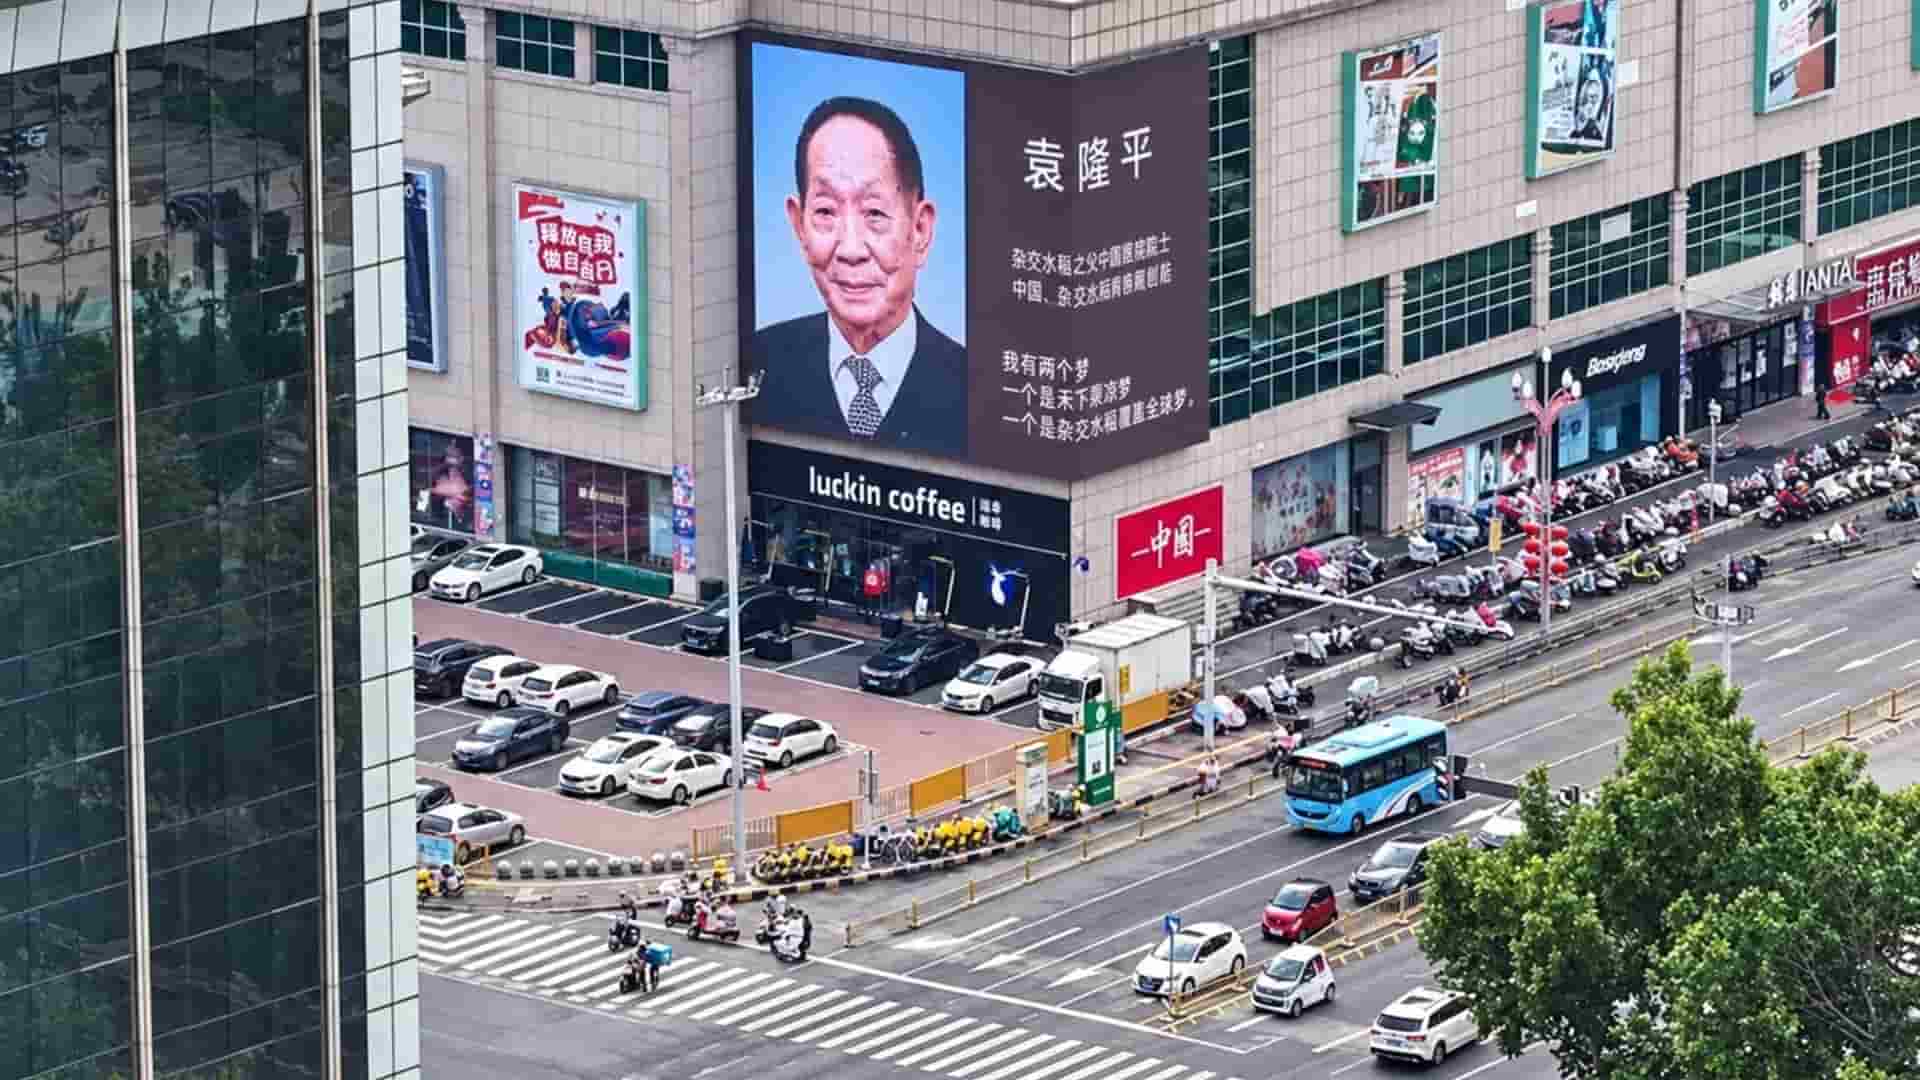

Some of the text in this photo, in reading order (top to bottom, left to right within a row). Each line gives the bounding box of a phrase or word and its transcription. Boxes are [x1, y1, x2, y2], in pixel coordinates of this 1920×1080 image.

[1023, 126, 1153, 193] 袁隆平
[1001, 349, 1090, 384] 我有两个梦
[808, 465, 966, 523] luckin coffee
